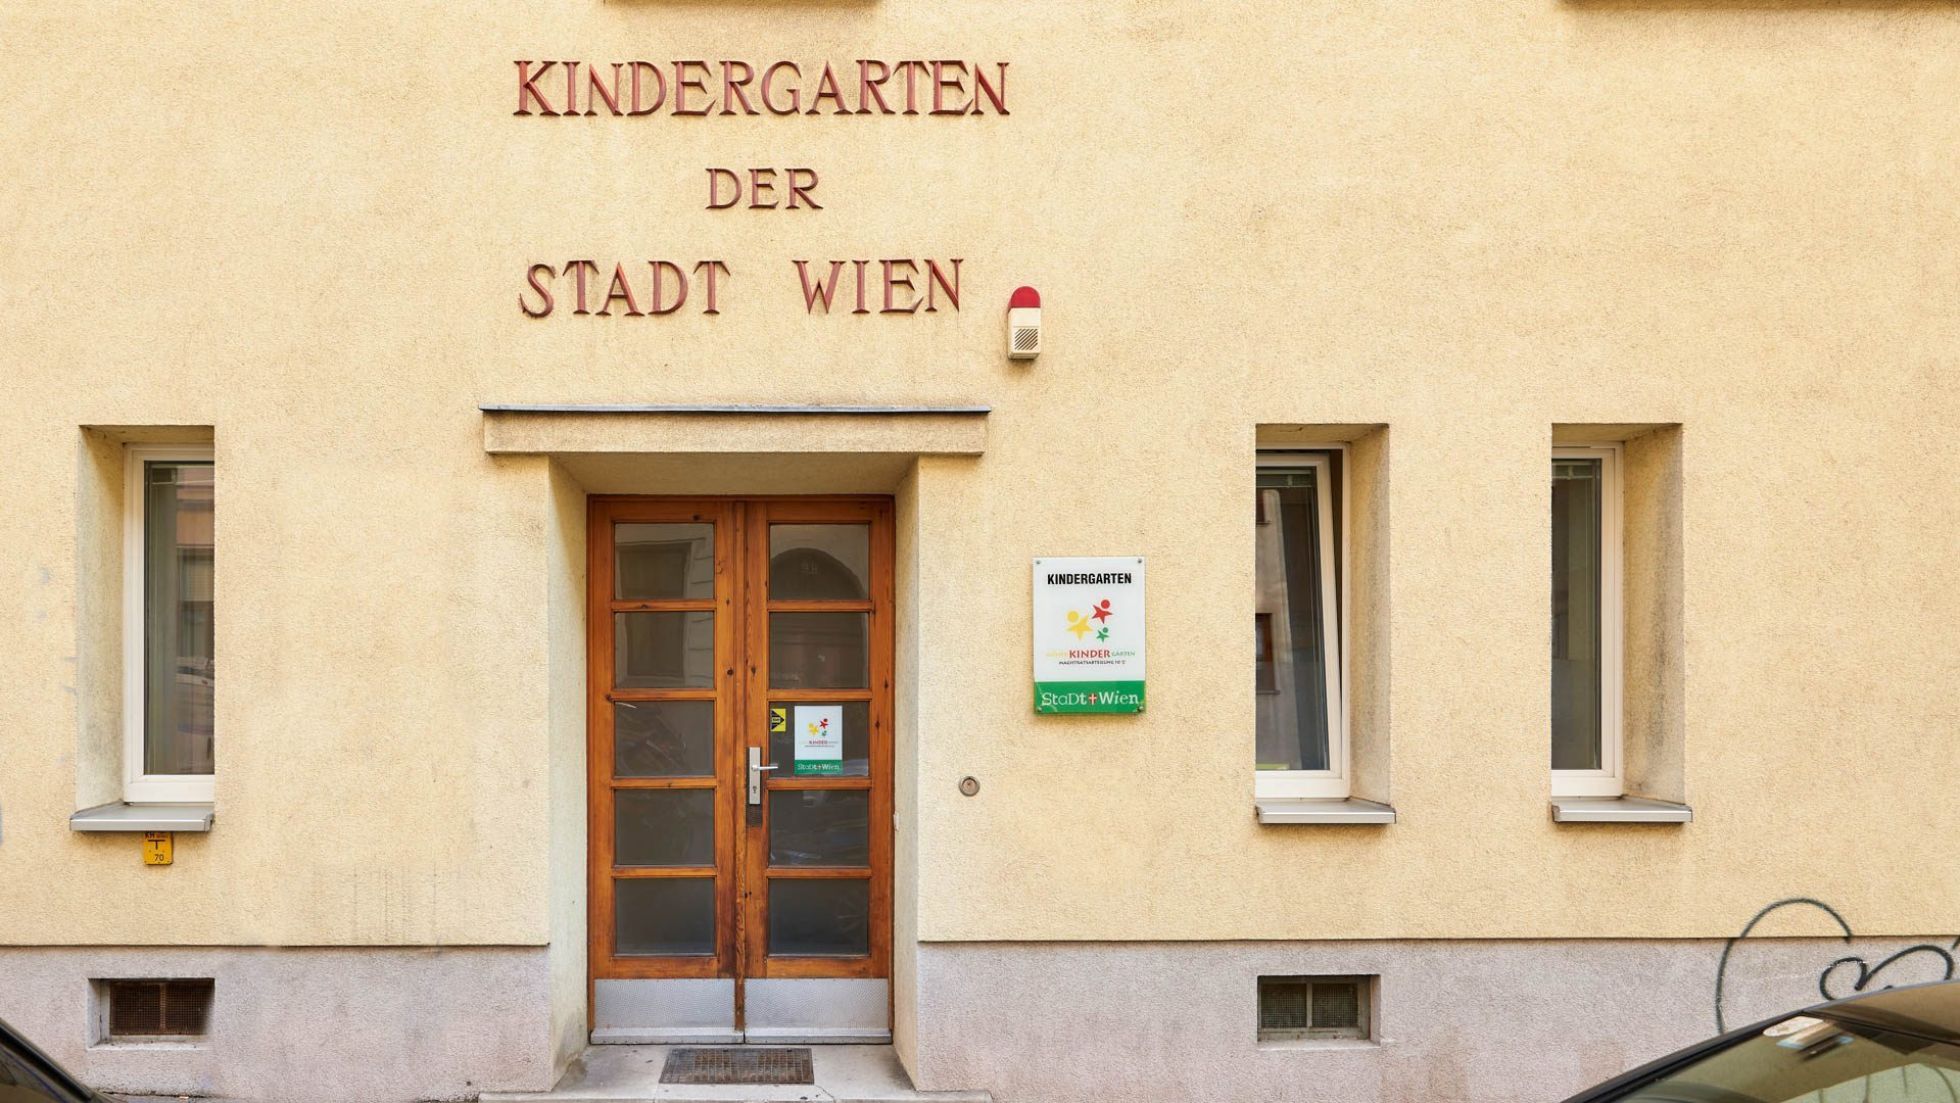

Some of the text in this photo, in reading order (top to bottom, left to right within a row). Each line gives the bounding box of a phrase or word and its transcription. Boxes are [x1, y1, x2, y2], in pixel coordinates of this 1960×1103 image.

[513, 60, 1010, 117] KINDERGARTEN
[706, 168, 824, 210] DER
[519, 259, 964, 319] STADT WIEN
[1047, 573, 1132, 585] KINDERGARTEN
[1069, 650, 1111, 658] KINDER
[154, 853, 165, 861] 70
